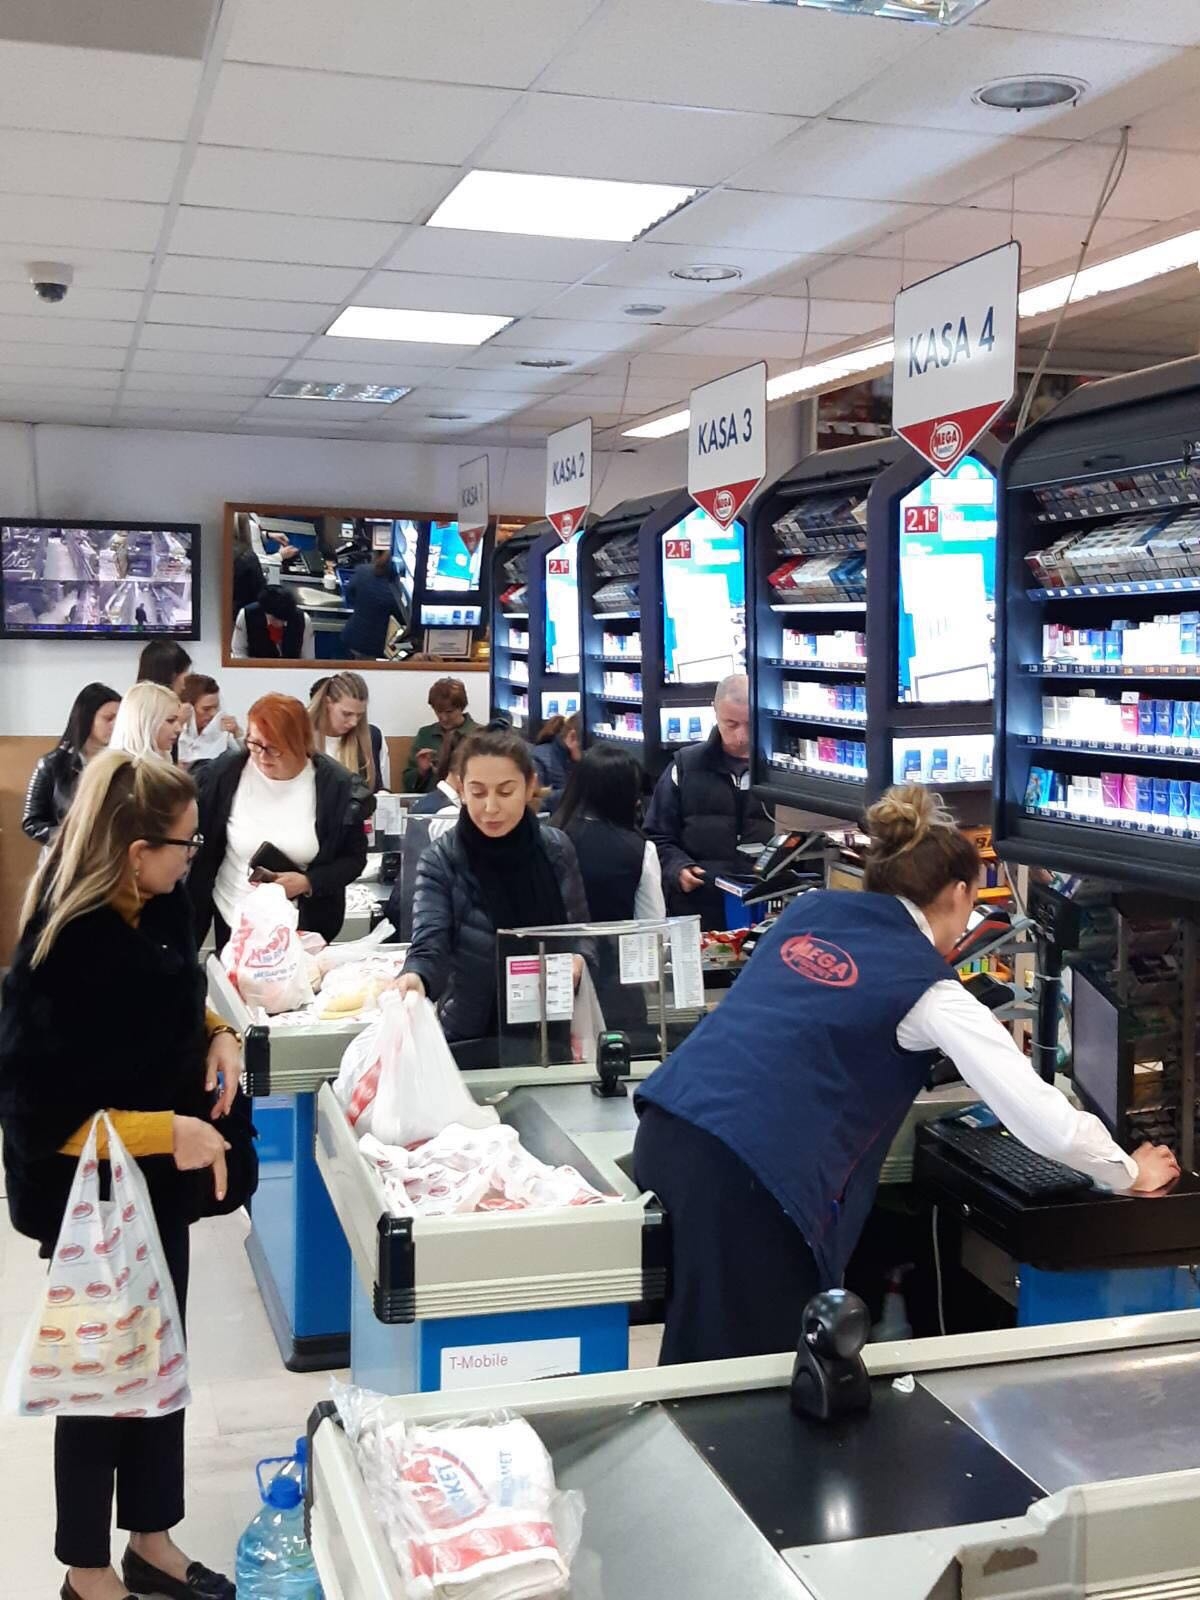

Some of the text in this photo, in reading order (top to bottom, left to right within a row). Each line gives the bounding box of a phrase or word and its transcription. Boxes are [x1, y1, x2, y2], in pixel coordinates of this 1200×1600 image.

[909, 306, 995, 378] KASA 4
[698, 407, 752, 455] KASA 3
[553, 451, 585, 486] KASA 2
[788, 942, 849, 980] MEGA
[449, 1353, 509, 1370] T-Mobile
